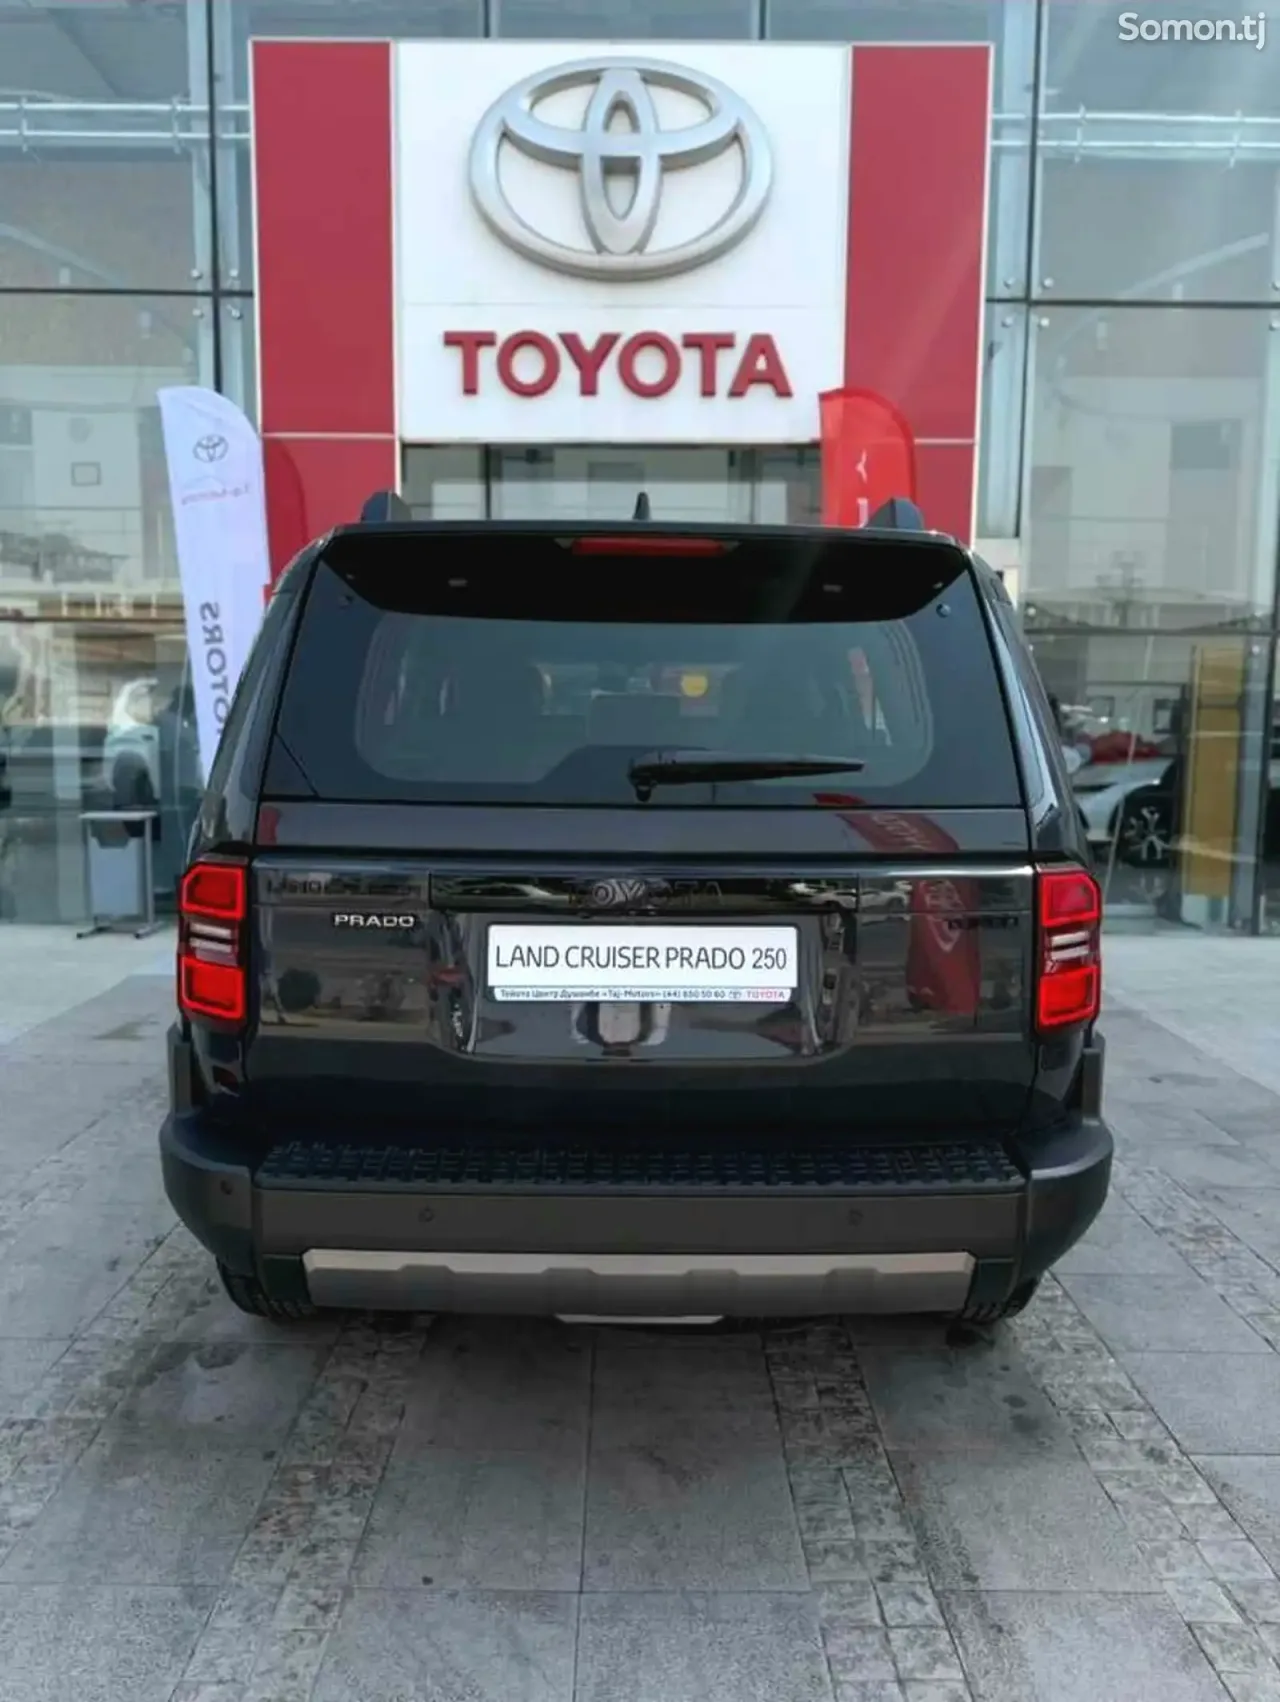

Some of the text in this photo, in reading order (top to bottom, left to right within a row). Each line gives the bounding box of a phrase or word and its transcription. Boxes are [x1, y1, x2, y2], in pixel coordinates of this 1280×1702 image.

[443, 330, 793, 398] TOYOTA
[333, 914, 415, 928] PRADO
[495, 945, 788, 970] LAND CRUISER PRADO 250
